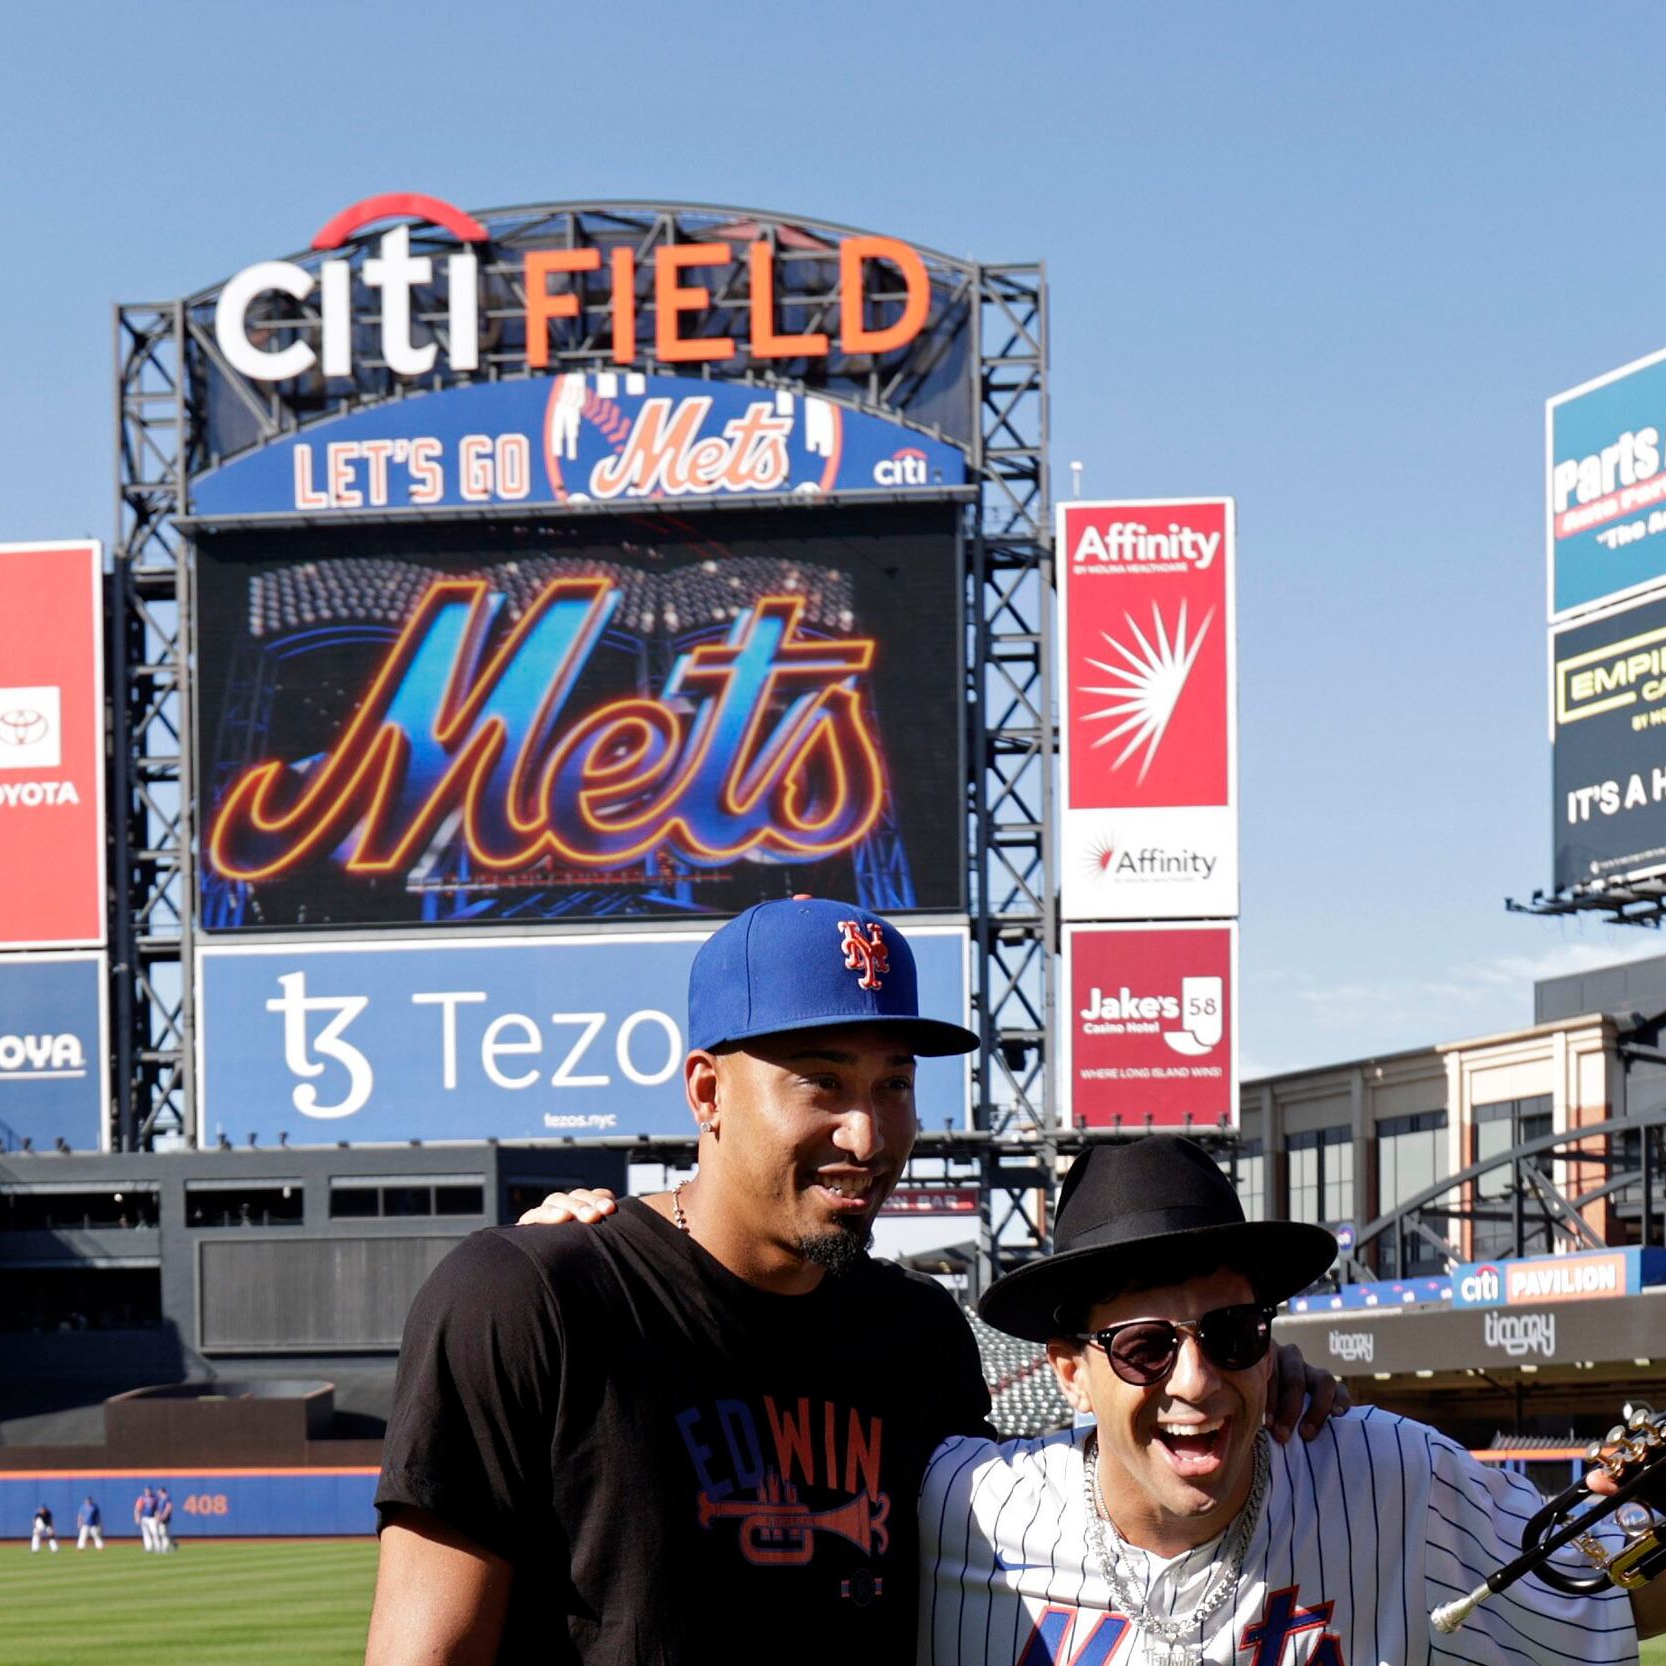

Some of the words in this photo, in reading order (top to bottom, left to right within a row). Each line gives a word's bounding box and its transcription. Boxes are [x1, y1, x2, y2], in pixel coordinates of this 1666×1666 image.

[214, 224, 480, 382] citi
[523, 236, 932, 368] FIELD
[293, 437, 445, 511] LET'S
[459, 433, 531, 501] GO
[588, 395, 795, 499] Mets
[873, 454, 927, 487] citi
[1554, 426, 1660, 514] Parts
[1562, 501, 1619, 532] Auto
[1073, 522, 1221, 570] Affinity
[208, 575, 882, 880] Mets
[1631, 713, 1649, 731] BY
[1567, 780, 1621, 824] IT'S
[1624, 774, 1648, 809] A
[1116, 848, 1217, 880] Affinity
[1080, 986, 1181, 1020] Jake's
[1189, 997, 1218, 1017] 58
[411, 990, 682, 1092] Tezo
[1083, 1022, 1125, 1035] Casino
[1127, 1019, 1160, 1034] Hotel
[1080, 1067, 1118, 1080] WHERE
[1119, 1067, 1151, 1079] LONG
[1151, 1066, 1190, 1079] ISLAND
[1191, 1065, 1223, 1078] WINS!
[543, 1112, 618, 1130] tezos.nyc
[1461, 1270, 1499, 1303] citi
[1511, 1262, 1617, 1298] PAVILION
[674, 1395, 883, 1503] EDWIN
[182, 1493, 229, 1516] 408
